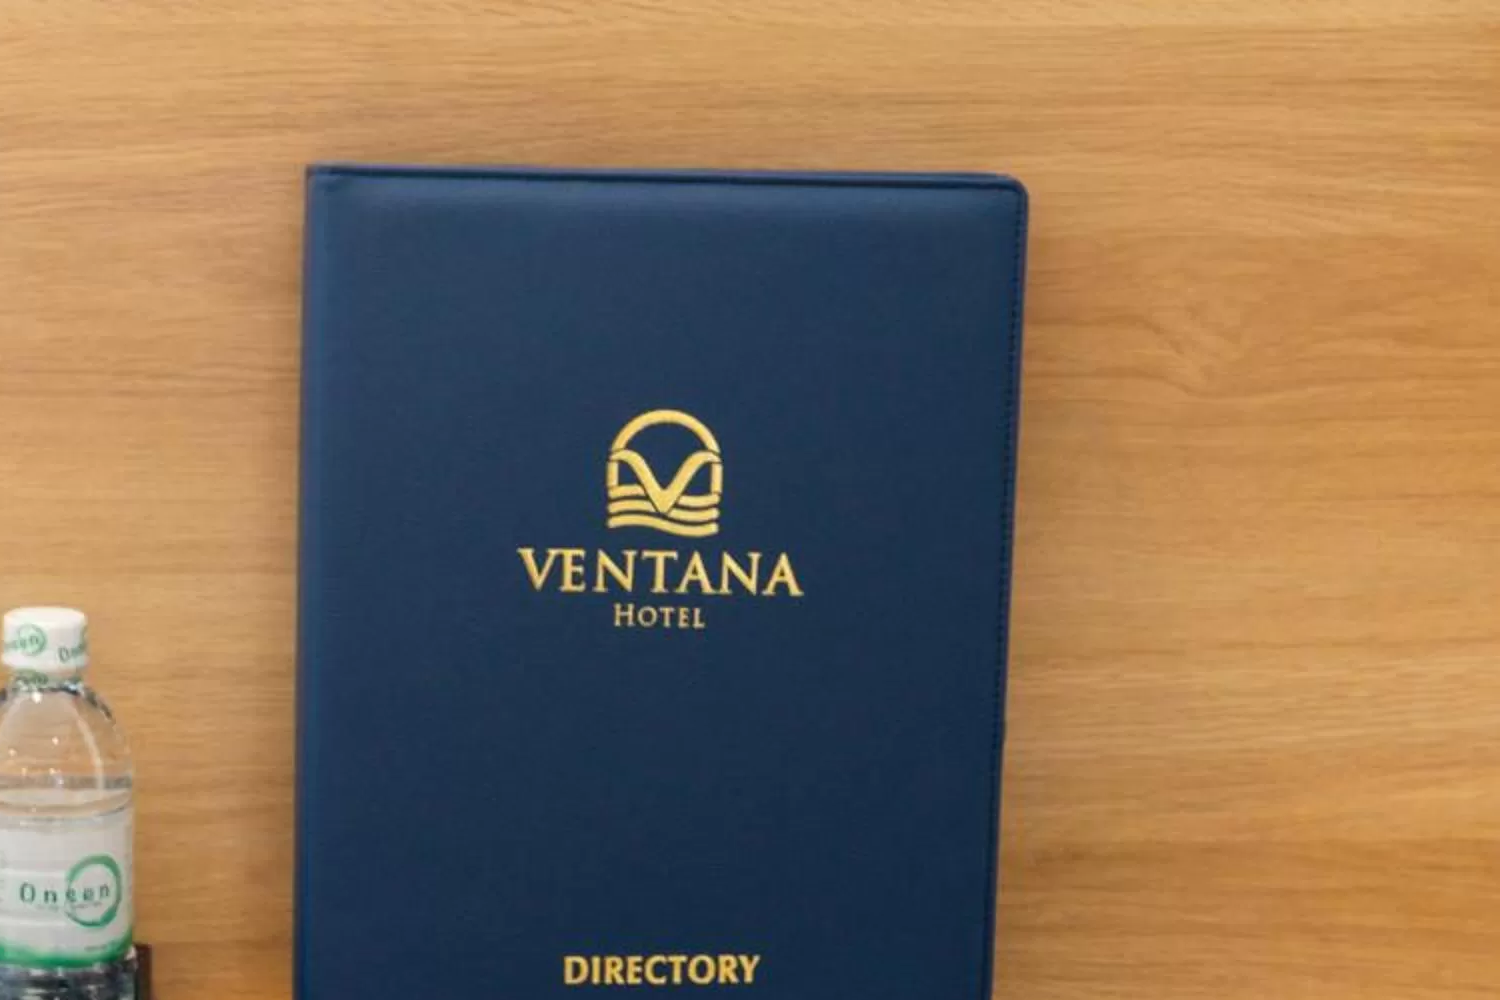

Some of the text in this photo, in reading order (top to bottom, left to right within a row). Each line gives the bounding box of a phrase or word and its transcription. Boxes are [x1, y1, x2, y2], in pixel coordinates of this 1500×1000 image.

[516, 547, 804, 596] VENTANA
[613, 602, 706, 629] HOTEL
[562, 953, 761, 985] DIRECTORY
